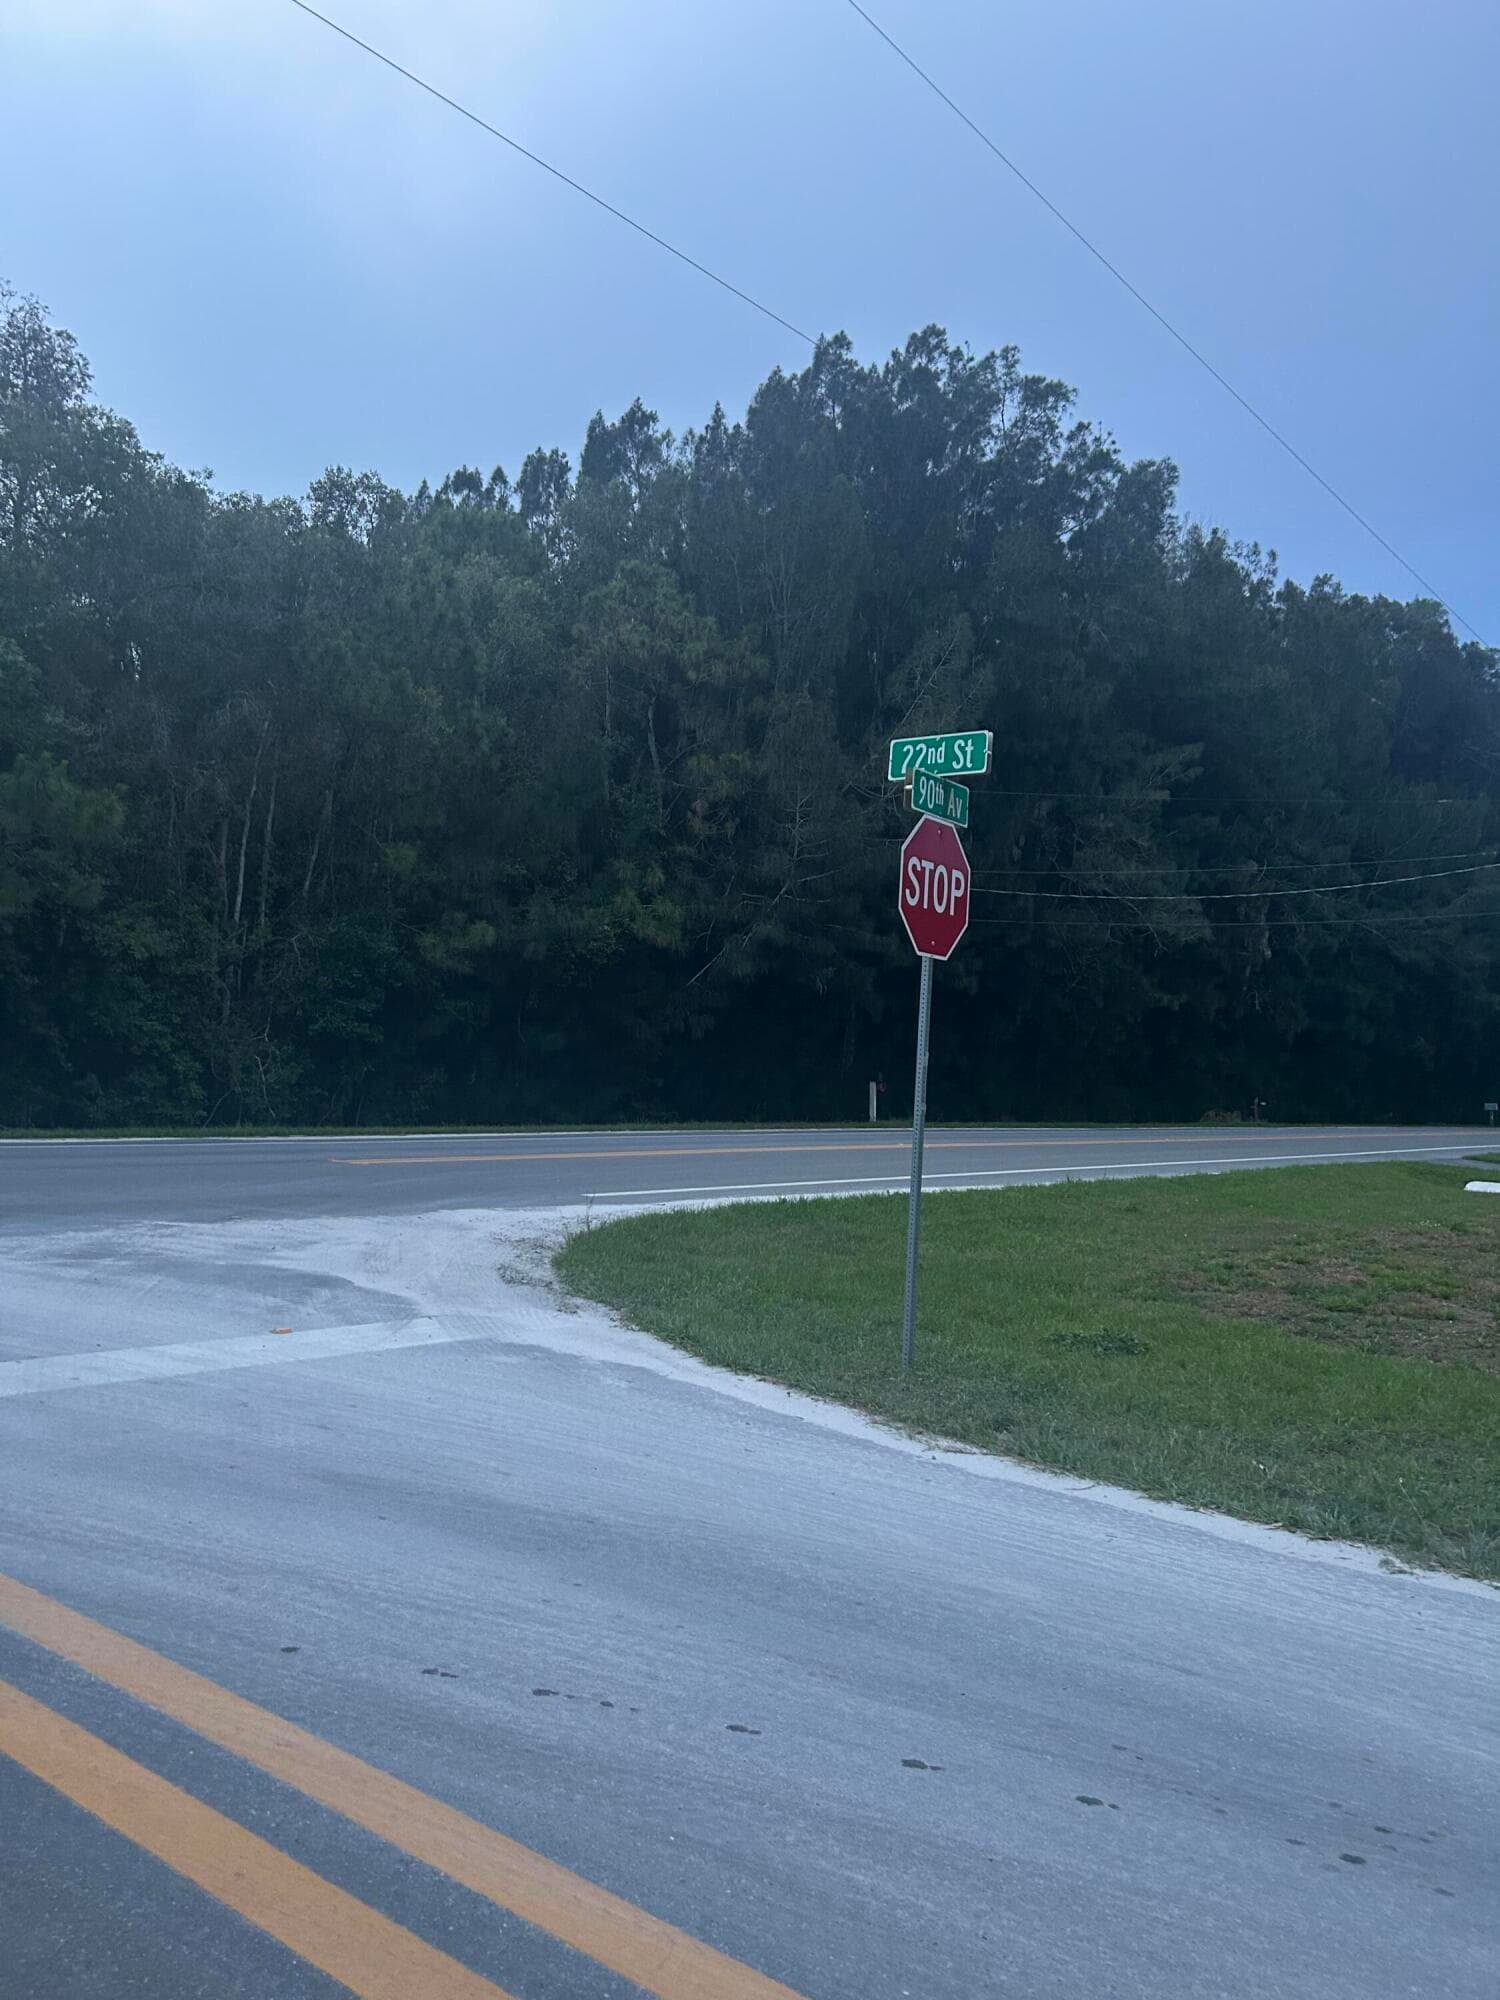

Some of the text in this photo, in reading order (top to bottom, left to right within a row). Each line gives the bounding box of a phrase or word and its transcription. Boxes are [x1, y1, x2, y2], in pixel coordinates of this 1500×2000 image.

[901, 739, 974, 774] 22nd St
[919, 776, 944, 809] 90th
[905, 856, 965, 916] STOP
